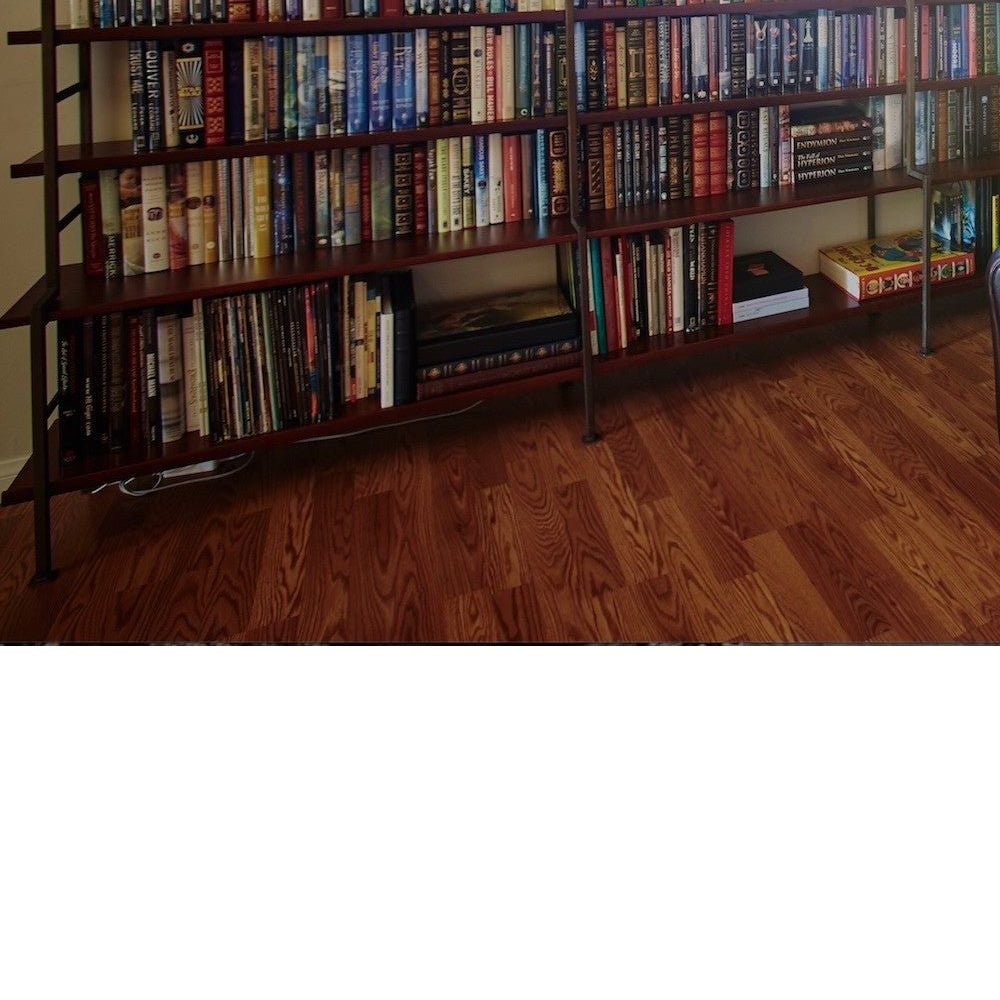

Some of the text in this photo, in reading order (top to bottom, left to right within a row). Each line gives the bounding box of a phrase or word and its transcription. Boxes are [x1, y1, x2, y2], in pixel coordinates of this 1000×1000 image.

[146, 49, 160, 99] QUIVER
[486, 28, 494, 121] NEW RULES BILL MAHER
[796, 138, 838, 149] ENDYMION
[797, 156, 836, 168] HYPERION
[797, 168, 836, 181] HYPERION
